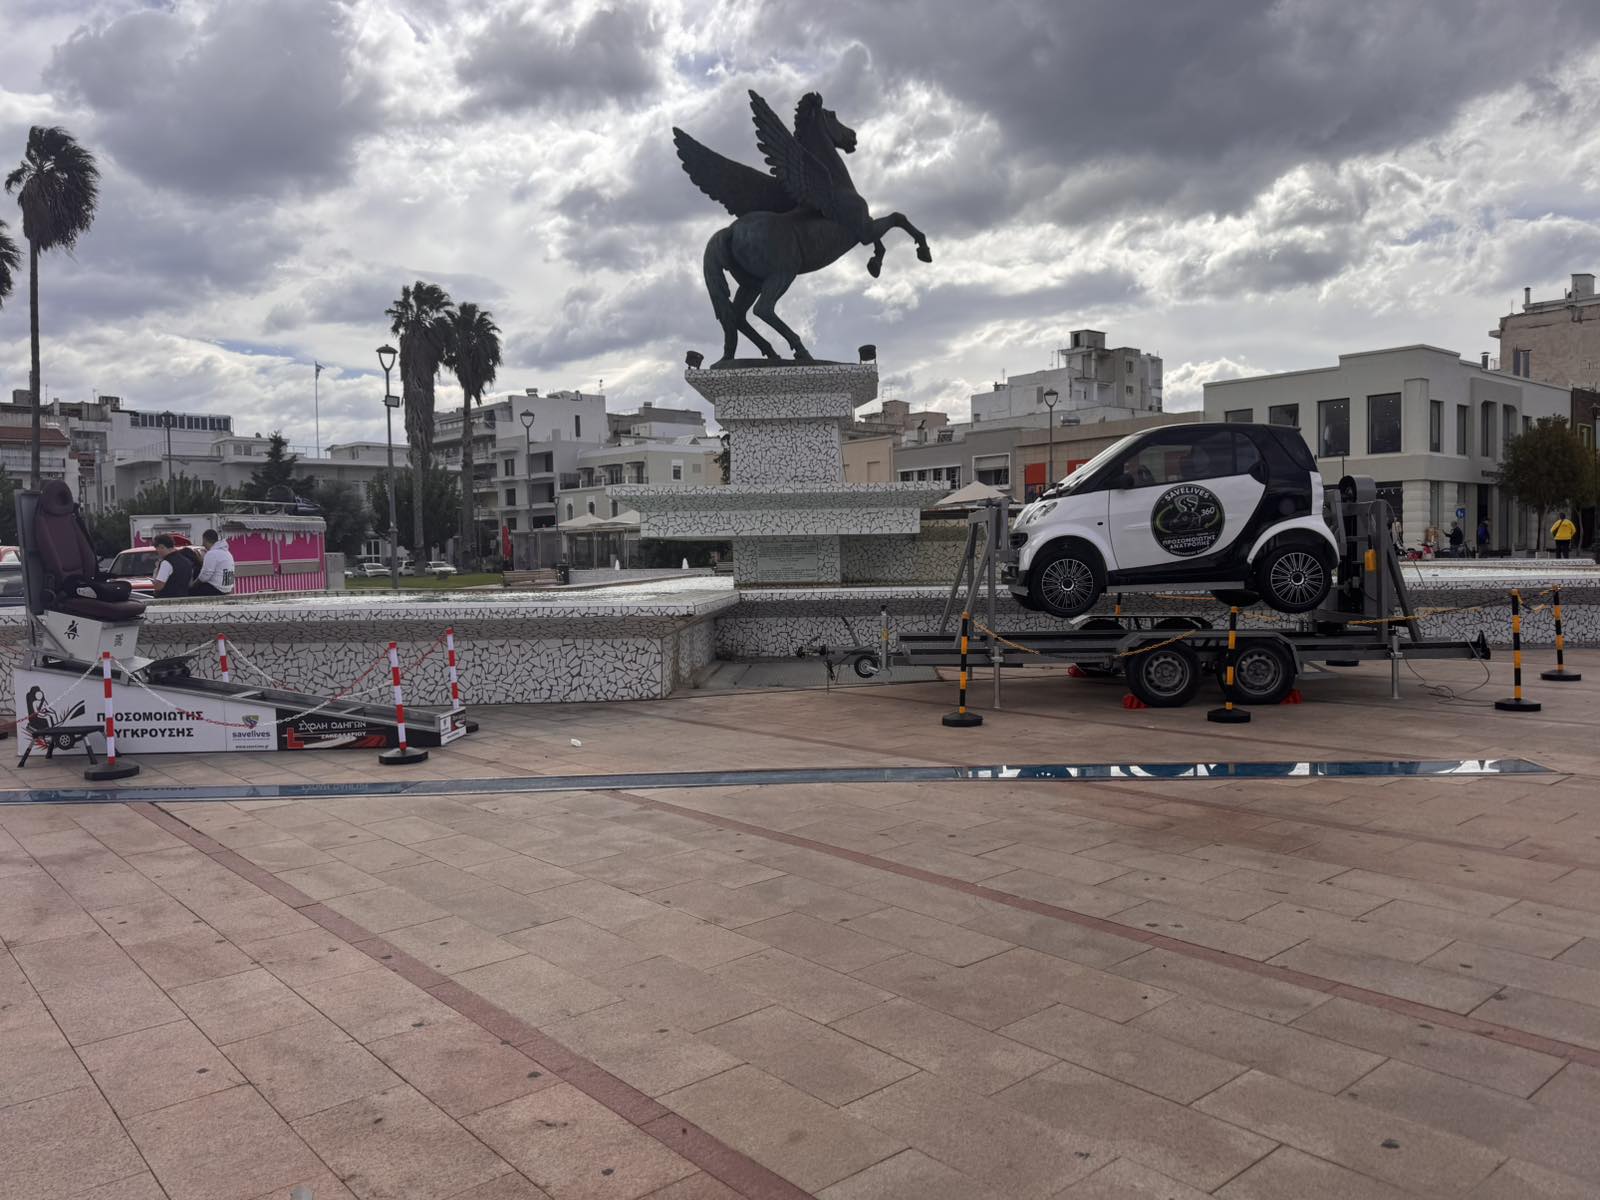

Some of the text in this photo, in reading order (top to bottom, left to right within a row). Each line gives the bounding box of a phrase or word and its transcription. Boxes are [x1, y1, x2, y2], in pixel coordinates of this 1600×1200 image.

[1165, 487, 1209, 501] SAVELIVES
[1201, 507, 1215, 516] 360
[97, 711, 204, 722] ΠΟΣΟΜΟΙΩΤΗΣ
[107, 728, 194, 739] ΥΓΚΡΟΥΣΗΣ
[232, 730, 271, 738] savelives
